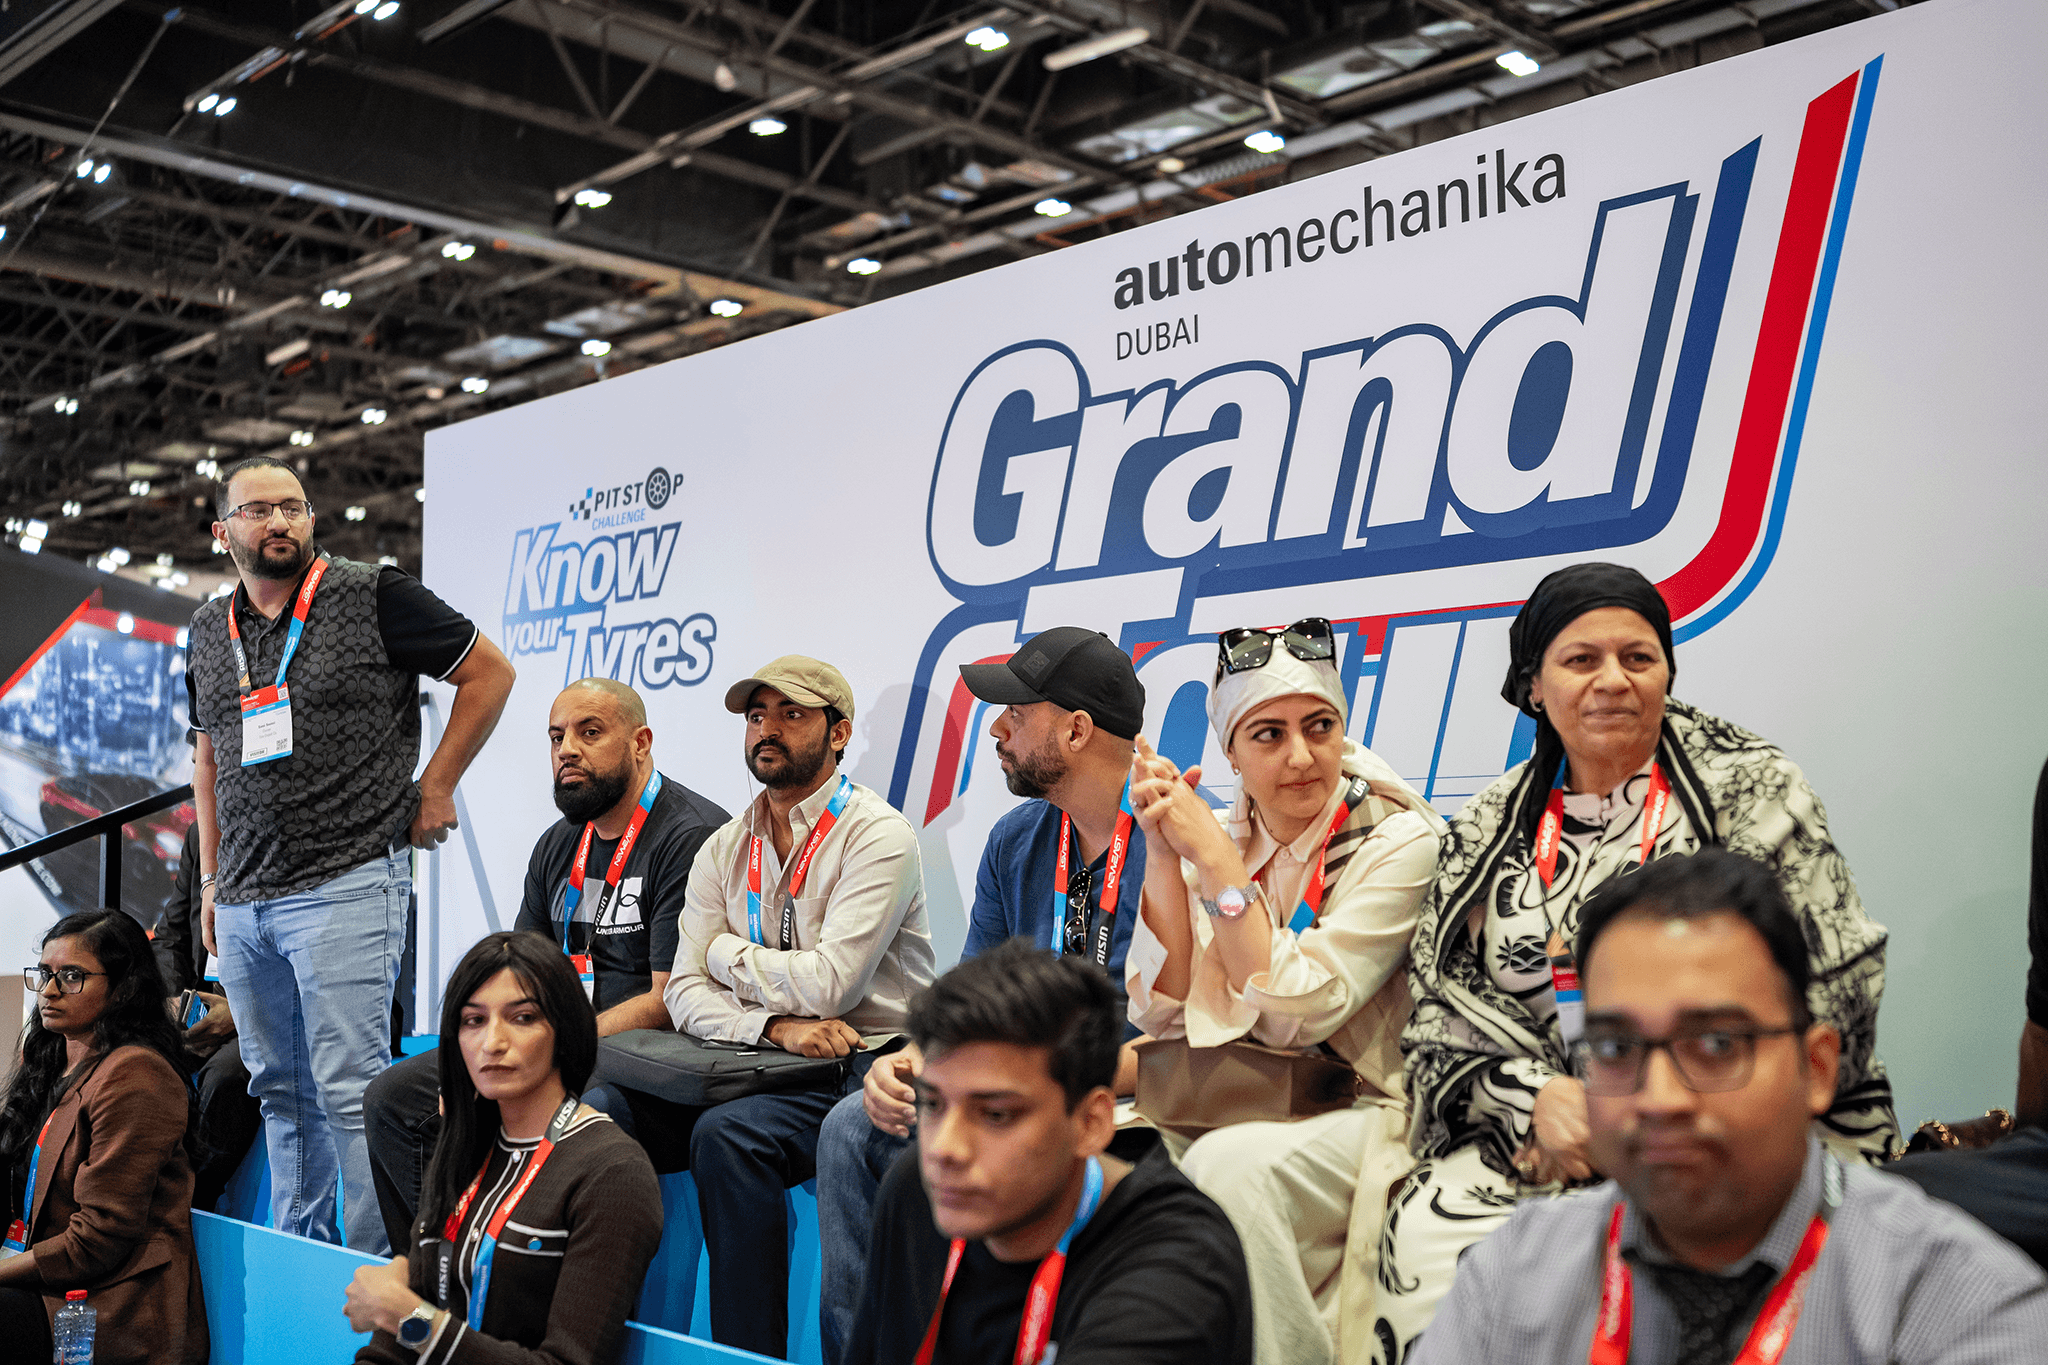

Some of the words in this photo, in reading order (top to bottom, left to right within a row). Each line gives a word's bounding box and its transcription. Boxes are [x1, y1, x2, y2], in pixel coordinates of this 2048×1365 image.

[1114, 148, 1567, 309] automechanika
[1116, 314, 1199, 360] DUBAI
[926, 180, 1700, 600] Grand
[594, 466, 684, 512] PITSTOP
[592, 508, 646, 531] CHALLENGE
[503, 521, 682, 615] Know
[503, 619, 563, 662] your
[1352, 778, 1368, 797] SIN
[782, 908, 790, 944] AISIN
[1096, 925, 1109, 966] AISIN
[439, 1255, 449, 1300] AISIN
